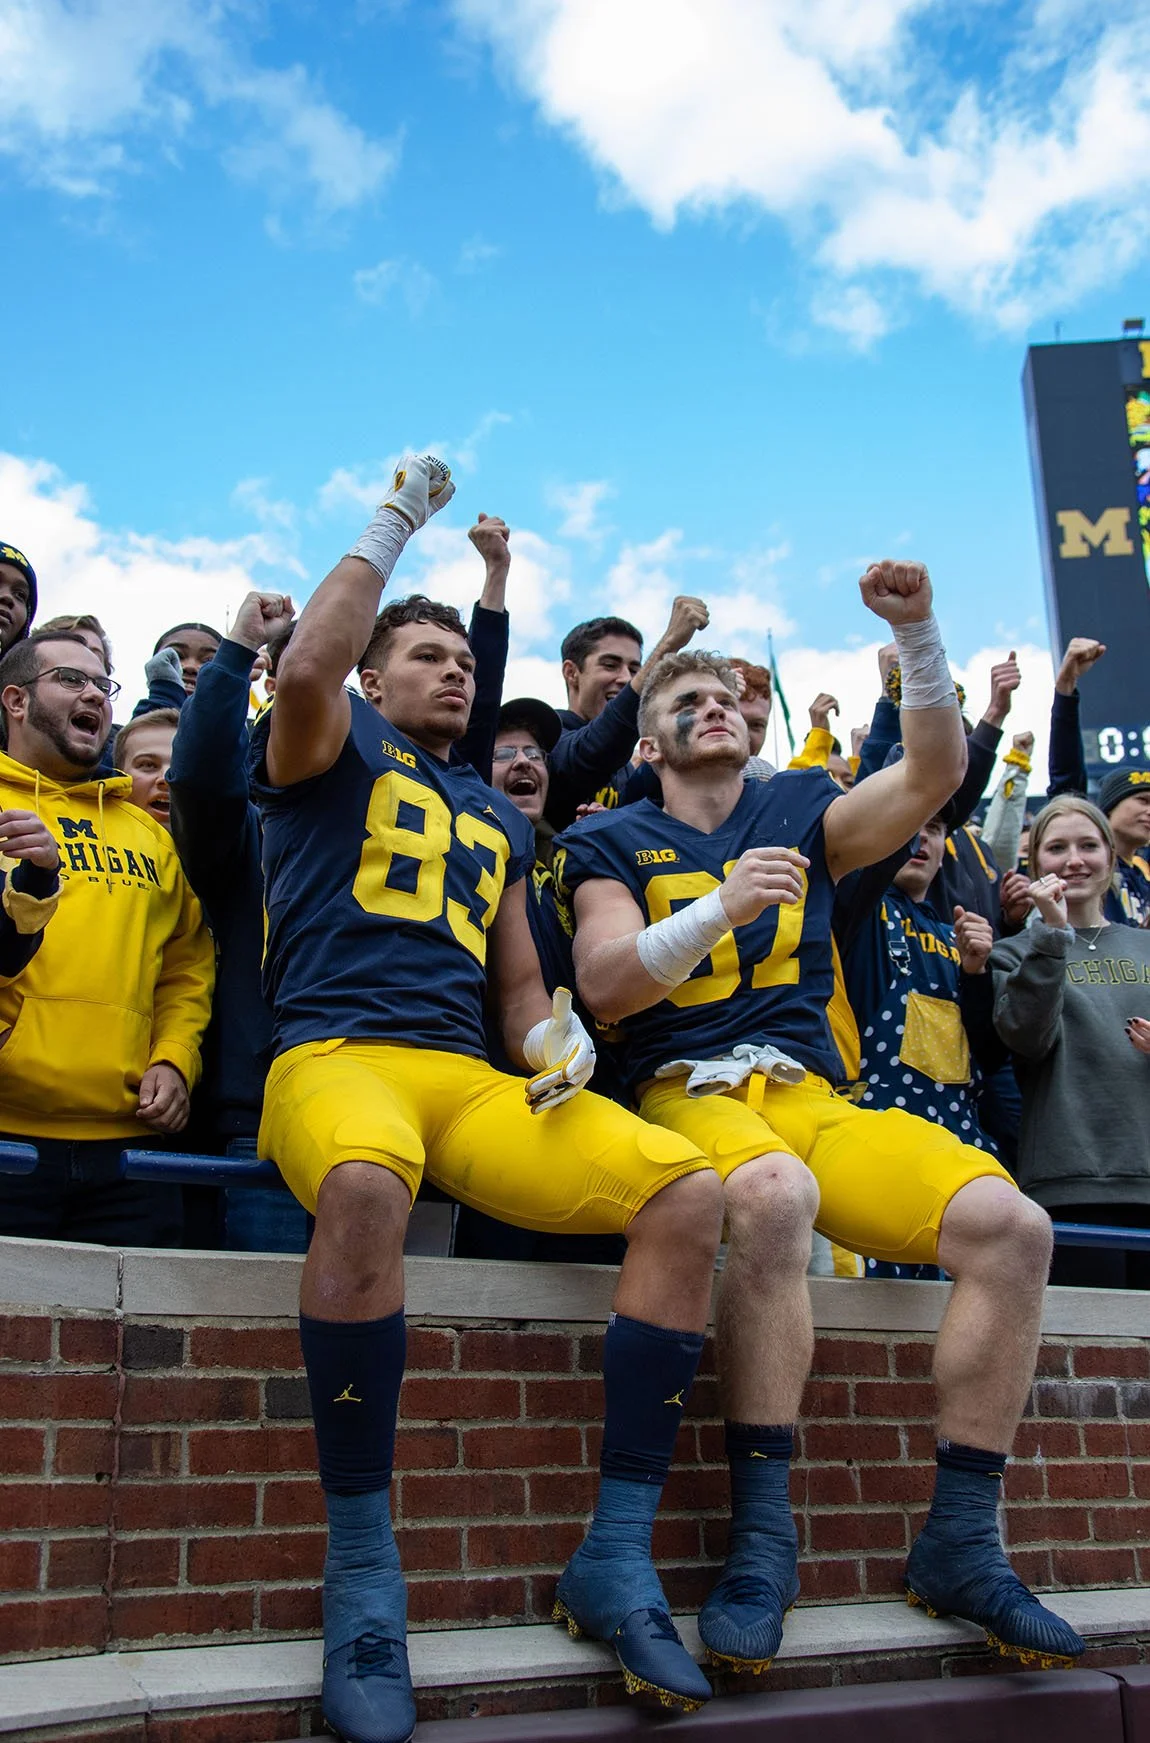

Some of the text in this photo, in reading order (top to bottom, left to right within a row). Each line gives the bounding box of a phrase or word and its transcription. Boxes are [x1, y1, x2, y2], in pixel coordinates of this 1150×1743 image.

[1056, 507, 1134, 558] M
[57, 816, 99, 840] M
[56, 842, 161, 888] HIGAN
[352, 770, 511, 967] 83
[1066, 958, 1150, 985] CHIG
